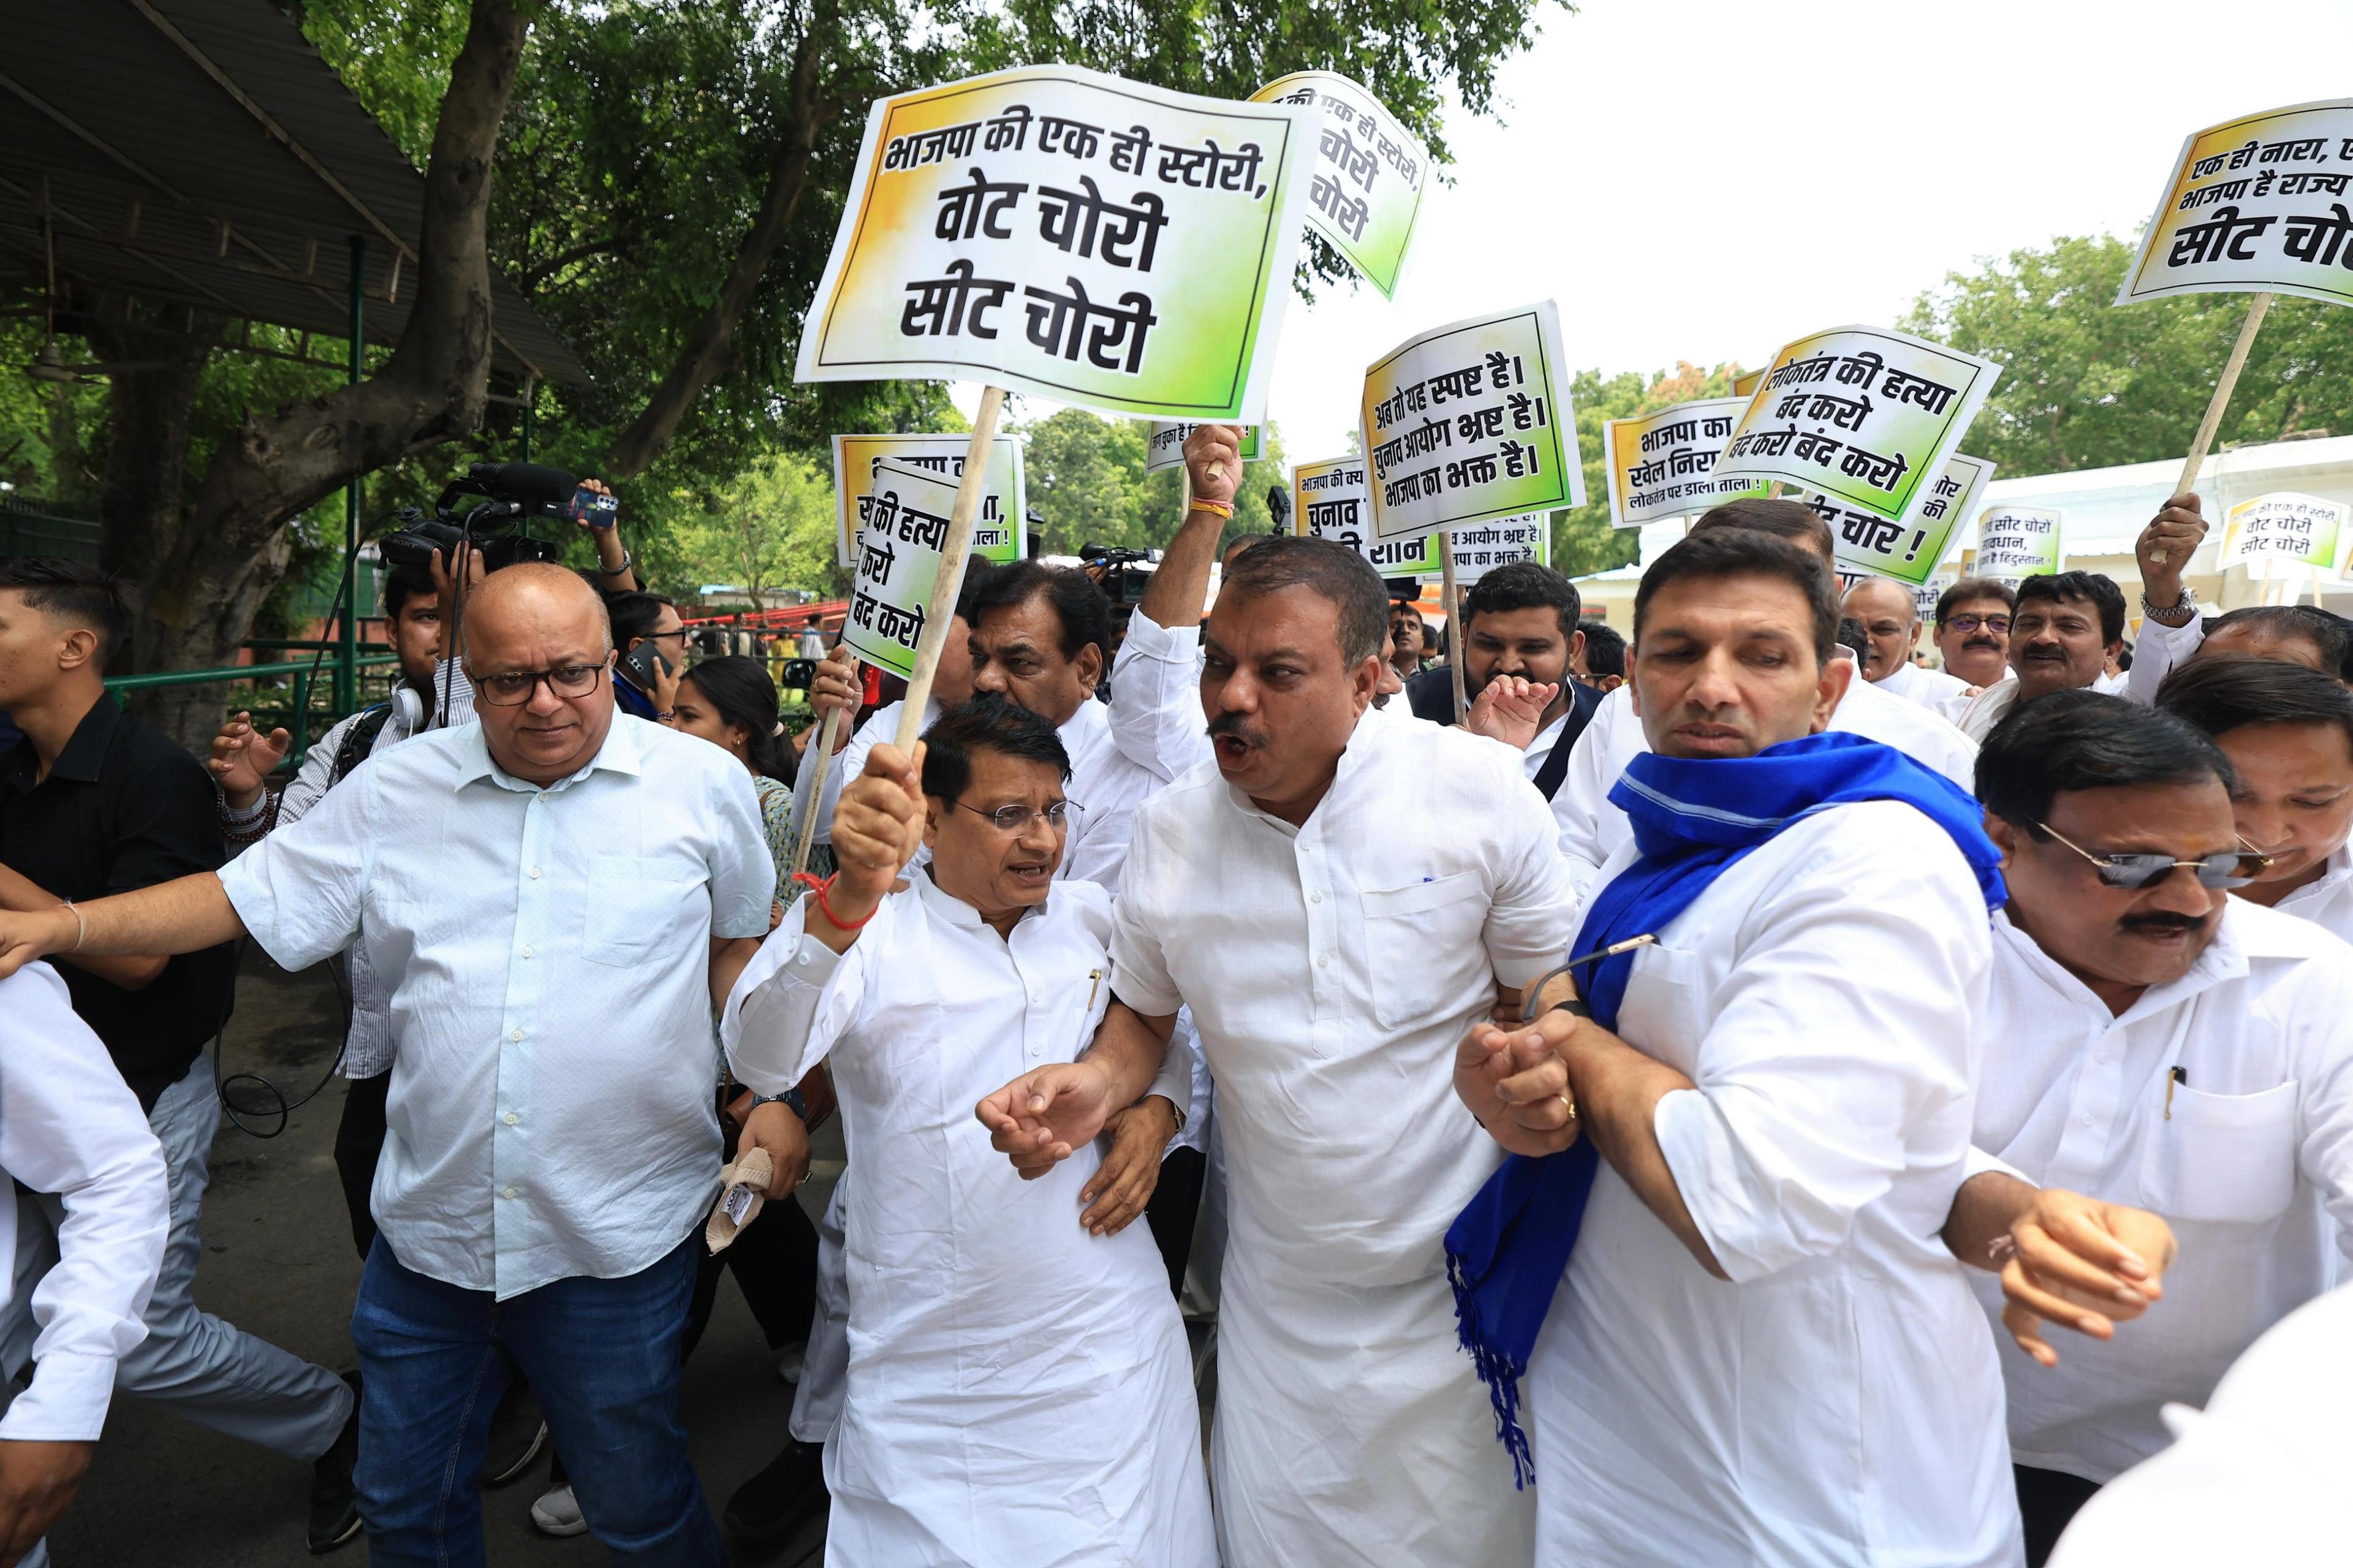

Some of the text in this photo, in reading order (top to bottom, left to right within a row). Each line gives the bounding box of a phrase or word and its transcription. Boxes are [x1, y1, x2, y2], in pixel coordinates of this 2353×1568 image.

[1320, 94, 1356, 123] एक
[1357, 113, 1377, 142] ही
[885, 104, 1269, 199] भाजपा की एक ही स्टोरी,
[1319, 128, 1379, 194] चोरी
[2191, 153, 2230, 180] एक
[2228, 141, 2259, 170] ही
[2259, 138, 2328, 164] नारा,
[1309, 173, 1369, 243] चोरी
[2179, 169, 2353, 210] भाजपा है राज्य
[934, 166, 1169, 271] वोट चोरी
[2168, 203, 2353, 271] सीट चो
[901, 258, 1156, 374] सीट चोरी
[1375, 352, 1524, 430] अब तो यह स्पष्ट है।
[1765, 350, 1957, 415] लोकतंत्र की हत्या
[1776, 387, 1873, 433] बंद करो
[1178, 423, 1185, 441] है
[1373, 393, 1546, 479] चुनाव आयोग भ्रष्ट है।
[1641, 417, 1732, 452] भाजपा का
[1385, 440, 1538, 507] भाजपा का भक्त है।
[1628, 460, 1665, 487] खेल
[1729, 425, 1909, 493] बंद करो बंद करो
[1302, 469, 1363, 491] भाजपा की क्य
[1629, 488, 1665, 508] लोकतंत्र
[1667, 485, 1681, 499] पर
[1685, 482, 1715, 496] डाला
[1931, 475, 1962, 498] ोर
[873, 491, 900, 535] की
[899, 507, 950, 552] हत्या
[1308, 499, 1360, 537] चुनाव
[1803, 494, 1841, 521] ीट
[1923, 499, 1947, 520] की
[1995, 516, 2021, 530] सीट
[2246, 515, 2313, 534] वोट चोरी
[392, 539, 418, 548] SONY
[973, 531, 998, 545] ाला
[1462, 527, 1500, 544] आयोग
[1504, 529, 1526, 544] भ्रष्ट
[2241, 536, 2310, 555] सीट चोरी
[1474, 552, 1491, 565] का
[854, 584, 877, 629] बंद
[877, 602, 926, 650] करो
[726, 1184, 740, 1210] JOCKEY
